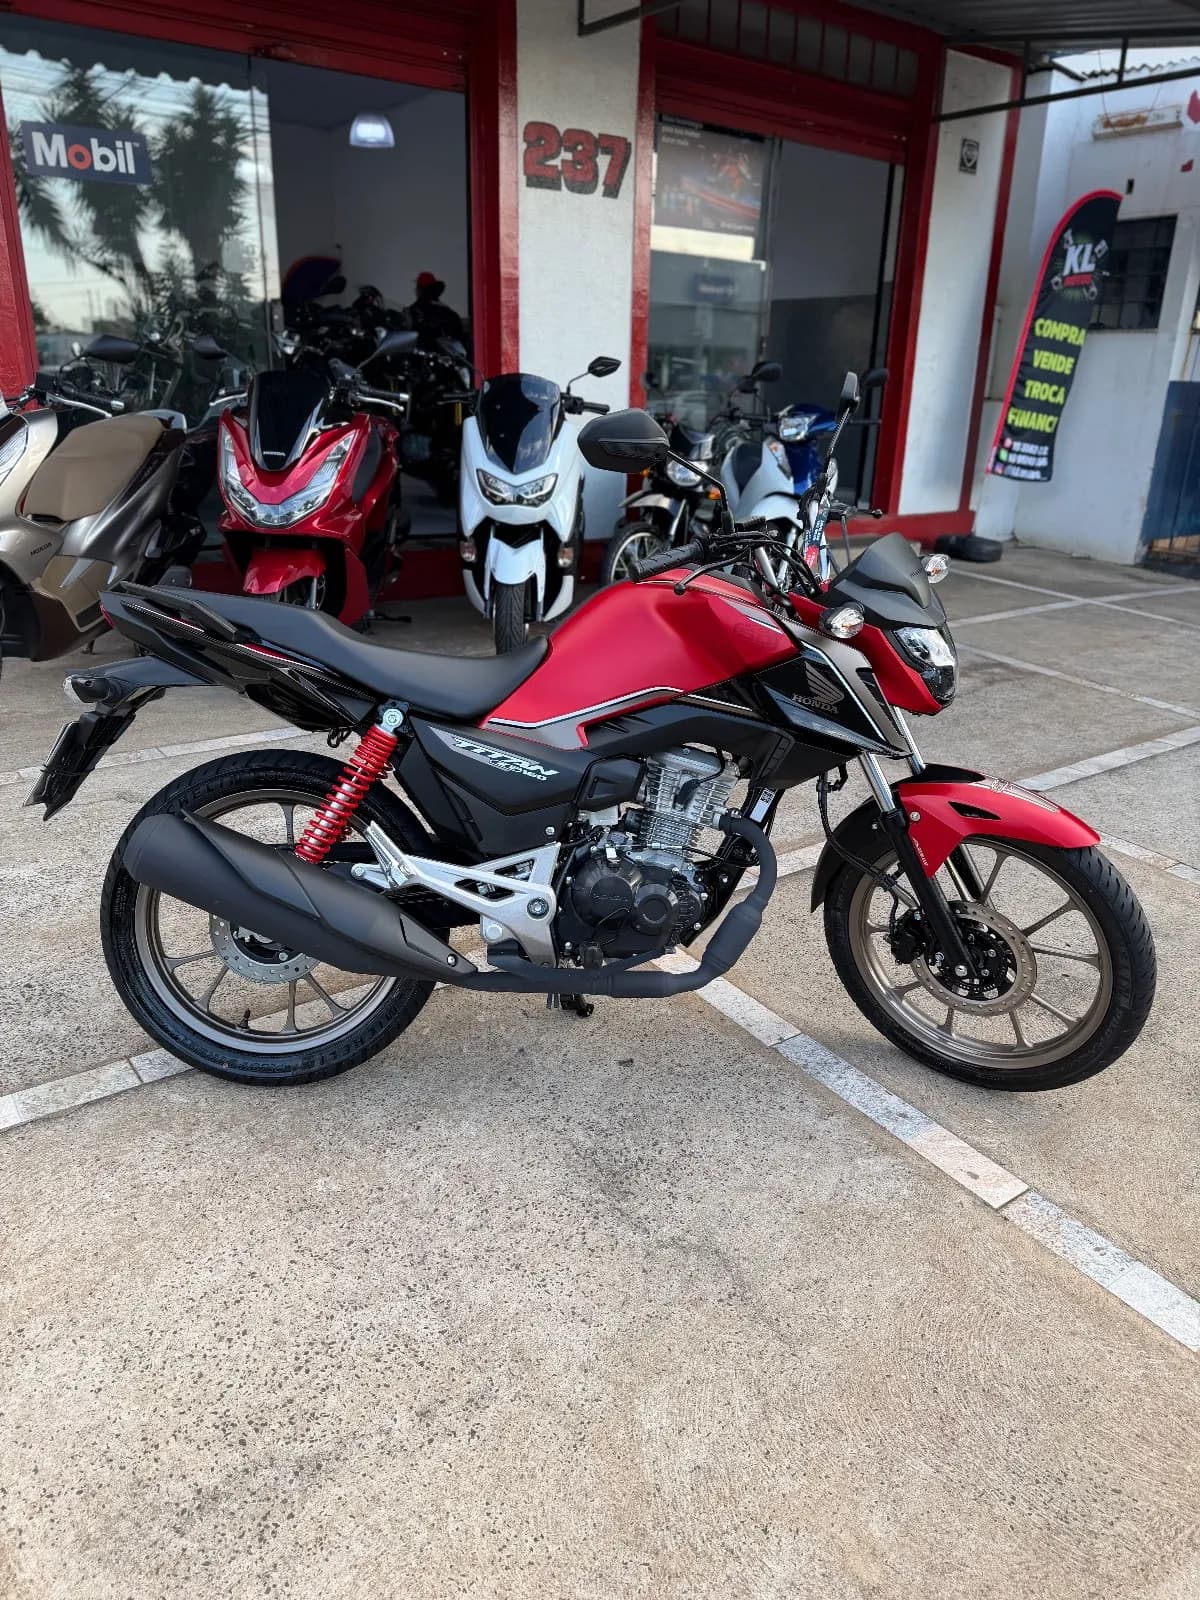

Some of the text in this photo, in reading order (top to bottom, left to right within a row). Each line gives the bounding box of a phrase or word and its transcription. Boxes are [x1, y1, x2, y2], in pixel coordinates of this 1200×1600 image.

[31, 131, 137, 175] Mobil
[523, 121, 633, 200] 237
[1062, 243, 1097, 277] KL
[1034, 318, 1087, 347] COMPRA
[1033, 349, 1075, 375] VENDE
[1024, 379, 1066, 405] TROCA
[791, 692, 840, 714] HONDA
[453, 735, 560, 776] TITAN
